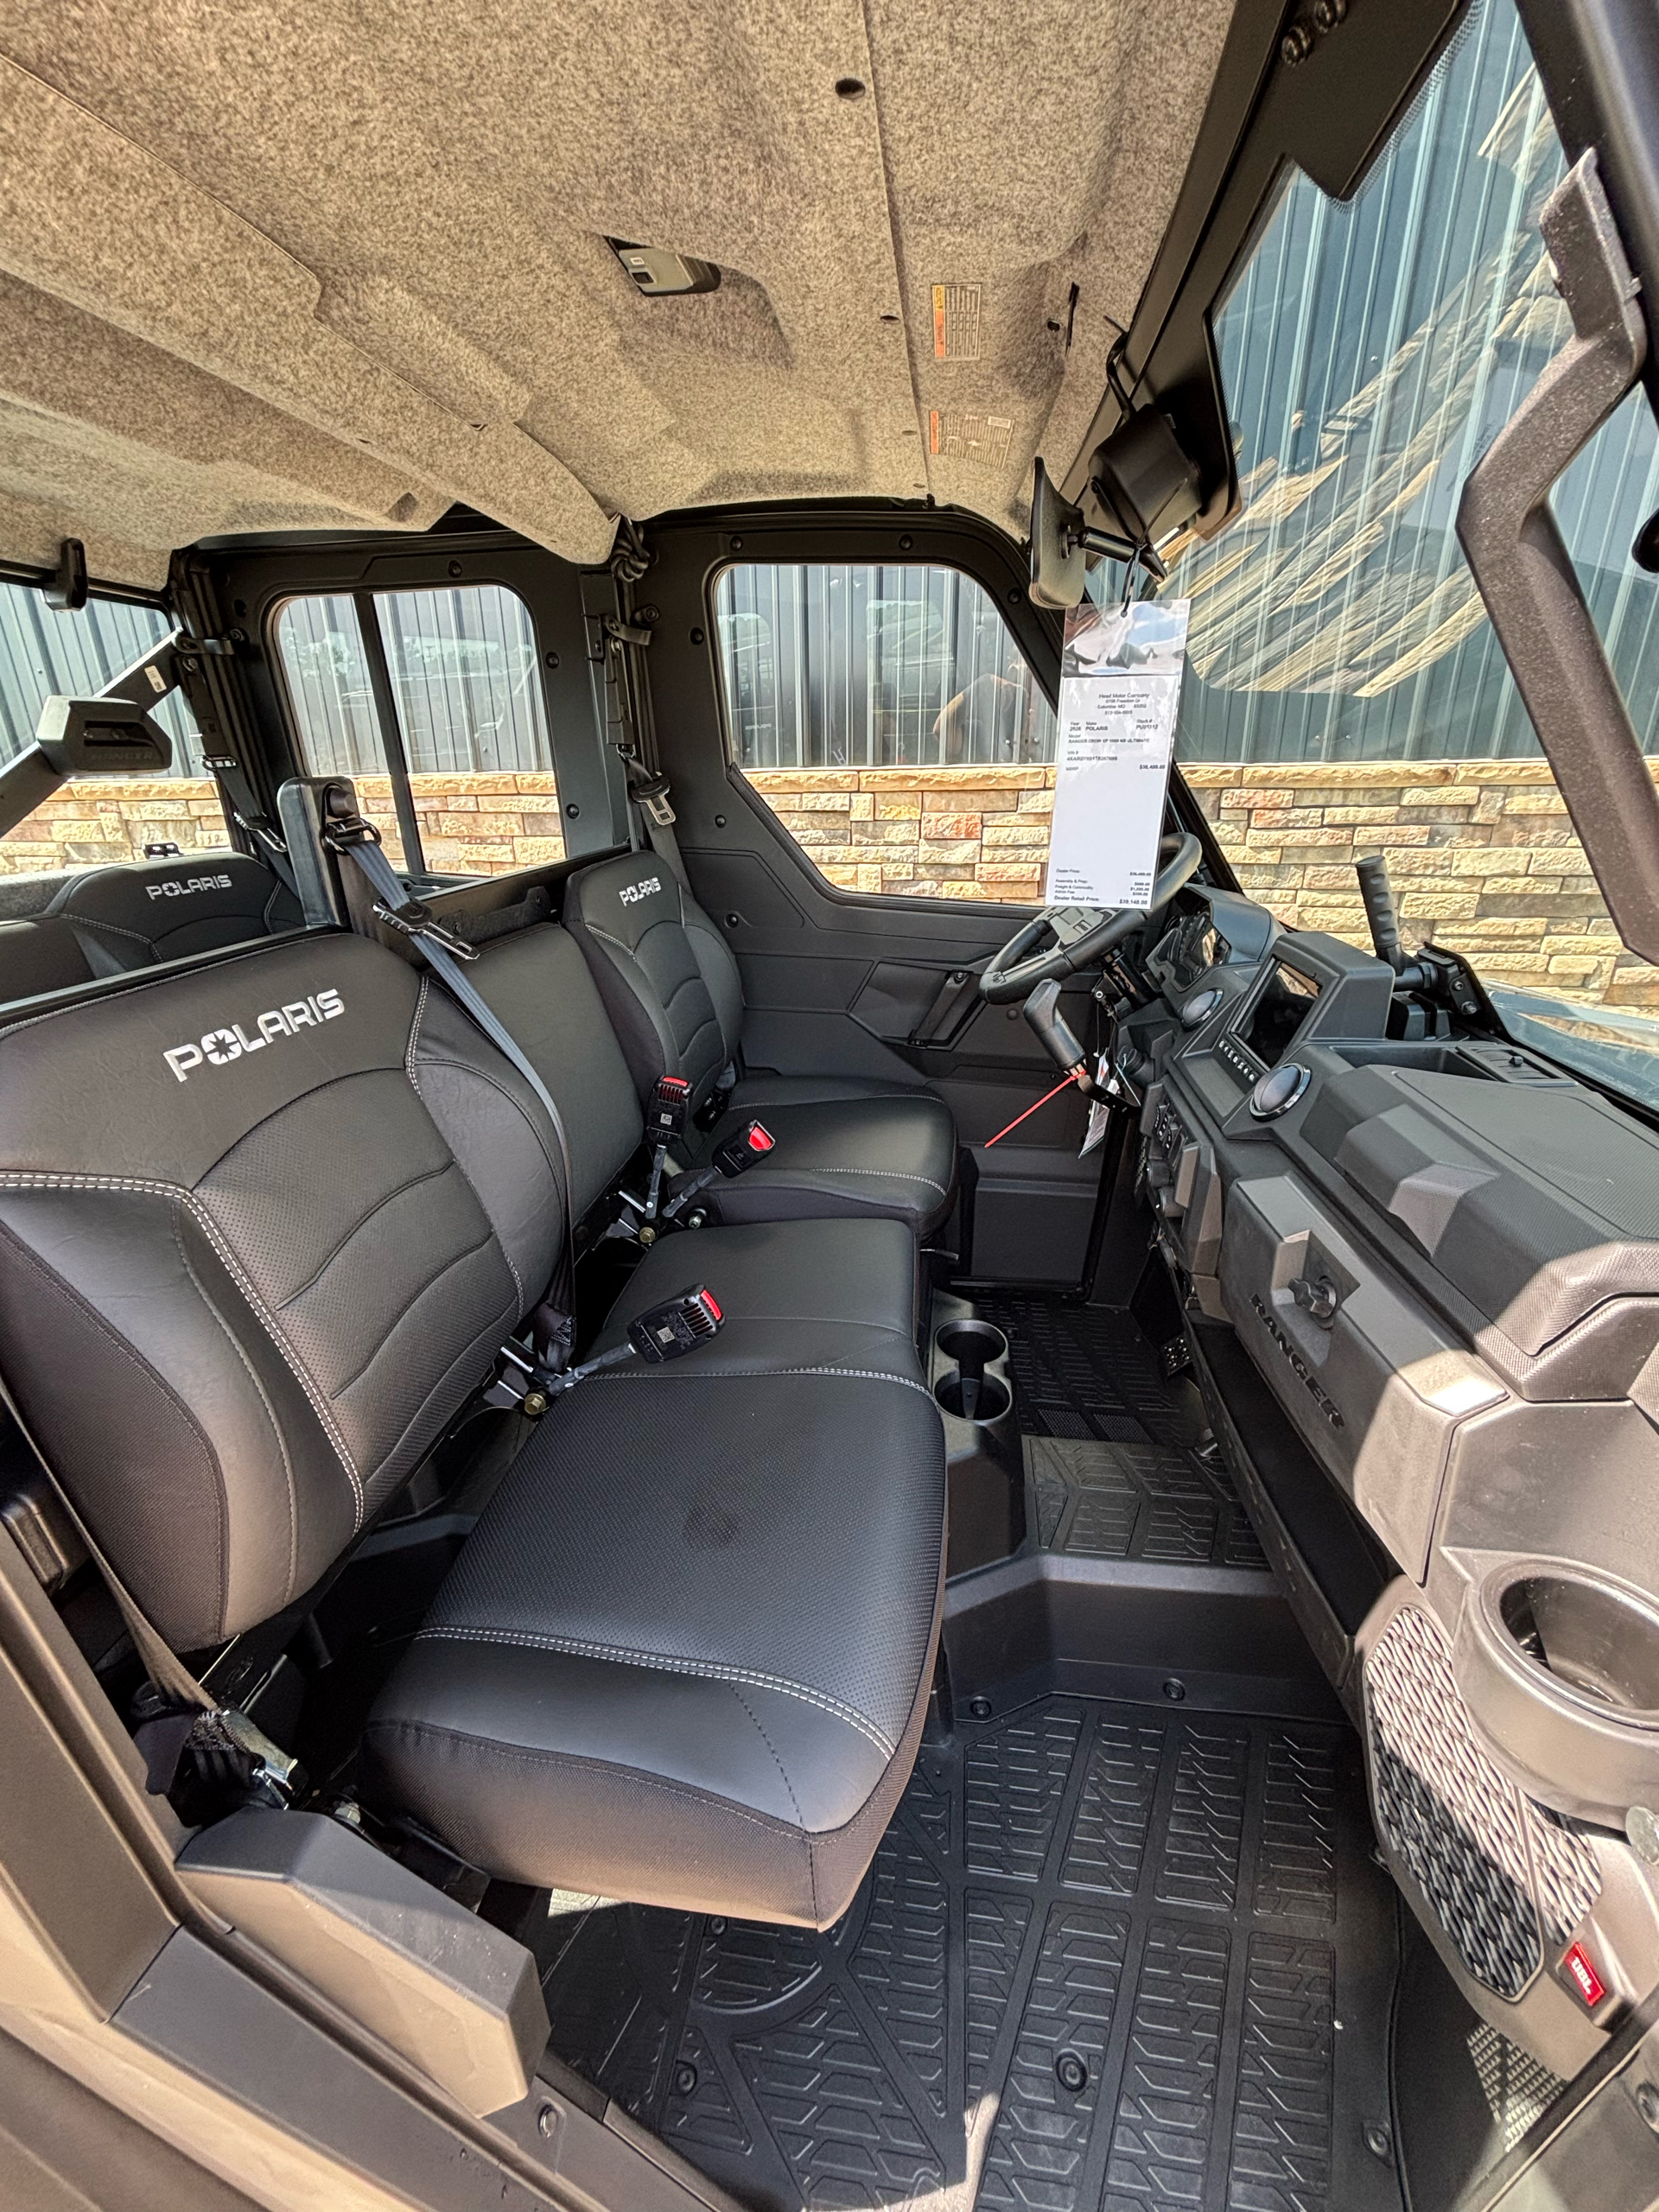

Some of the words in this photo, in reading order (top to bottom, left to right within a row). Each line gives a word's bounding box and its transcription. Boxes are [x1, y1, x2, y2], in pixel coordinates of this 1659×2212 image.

[145, 874, 232, 899] POLARIS
[619, 877, 661, 906] POLARIS
[163, 988, 345, 1083] POLARIS
[1249, 1294, 1345, 1430] RANGER
